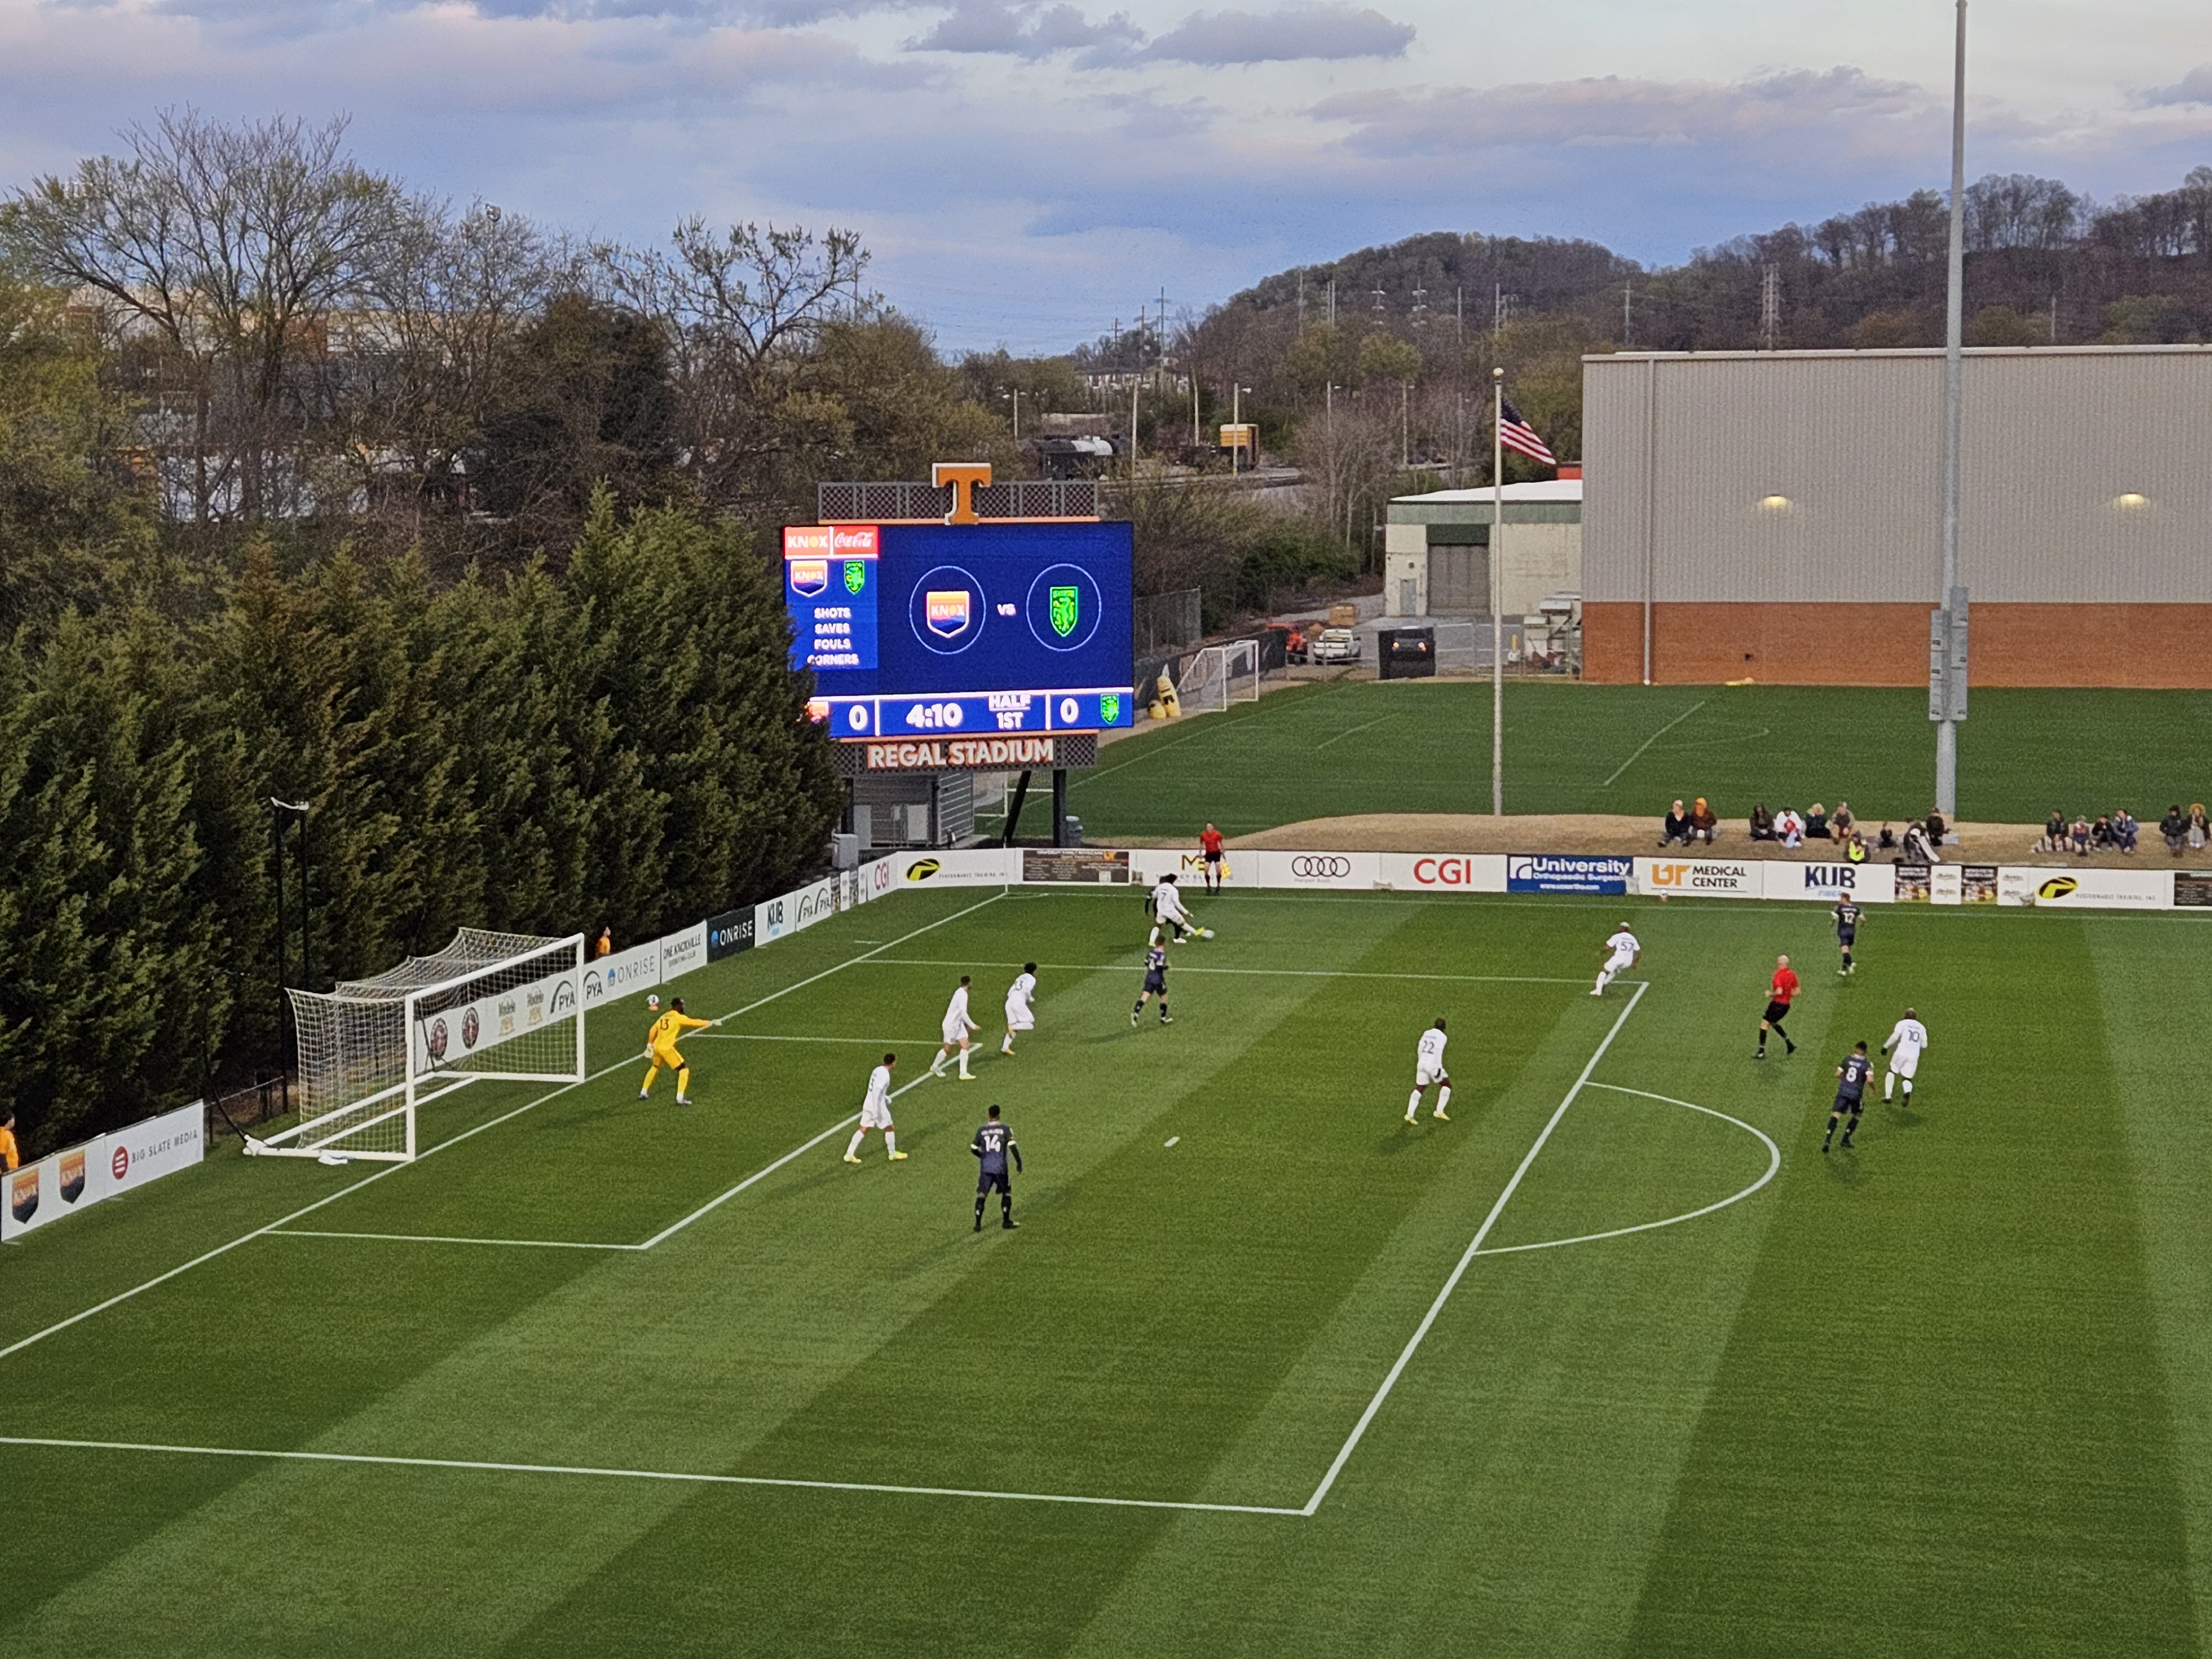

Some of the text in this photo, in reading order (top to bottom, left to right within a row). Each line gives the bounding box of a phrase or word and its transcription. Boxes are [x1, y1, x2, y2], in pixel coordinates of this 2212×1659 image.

[932, 462, 991, 525] T
[787, 535, 828, 548] KNOX
[794, 570, 824, 581] KNOX
[814, 607, 852, 619] SHOTS
[931, 604, 966, 617] KNOX
[815, 623, 851, 635] SAVES
[814, 638, 852, 650] FOULS
[807, 653, 859, 666] CORNERS
[989, 694, 1031, 708] HALF
[1060, 697, 1078, 723] 0
[848, 705, 868, 731] 0
[906, 702, 963, 728] 4:10
[996, 711, 1024, 729] 1ST
[867, 738, 1054, 769] REGAL STADIUM
[875, 859, 889, 890] CGI
[1413, 858, 1471, 884] CGI
[1533, 858, 1630, 875] University
[1652, 864, 1692, 886] UT
[1692, 865, 1746, 877] MEDICAL
[1692, 877, 1738, 888] CENTER
[1805, 865, 1856, 889] KUB
[719, 920, 753, 946] ONRISE
[617, 955, 655, 983] ONRISE
[587, 980, 603, 1000] PYA
[559, 990, 576, 1011] PYA
[660, 1018, 670, 1031] 13
[1421, 1040, 1436, 1055] 22
[1846, 1066, 1858, 1082] 8
[132, 1129, 198, 1164] BIG SLATE MEDIA
[983, 1134, 1001, 1153] 14
